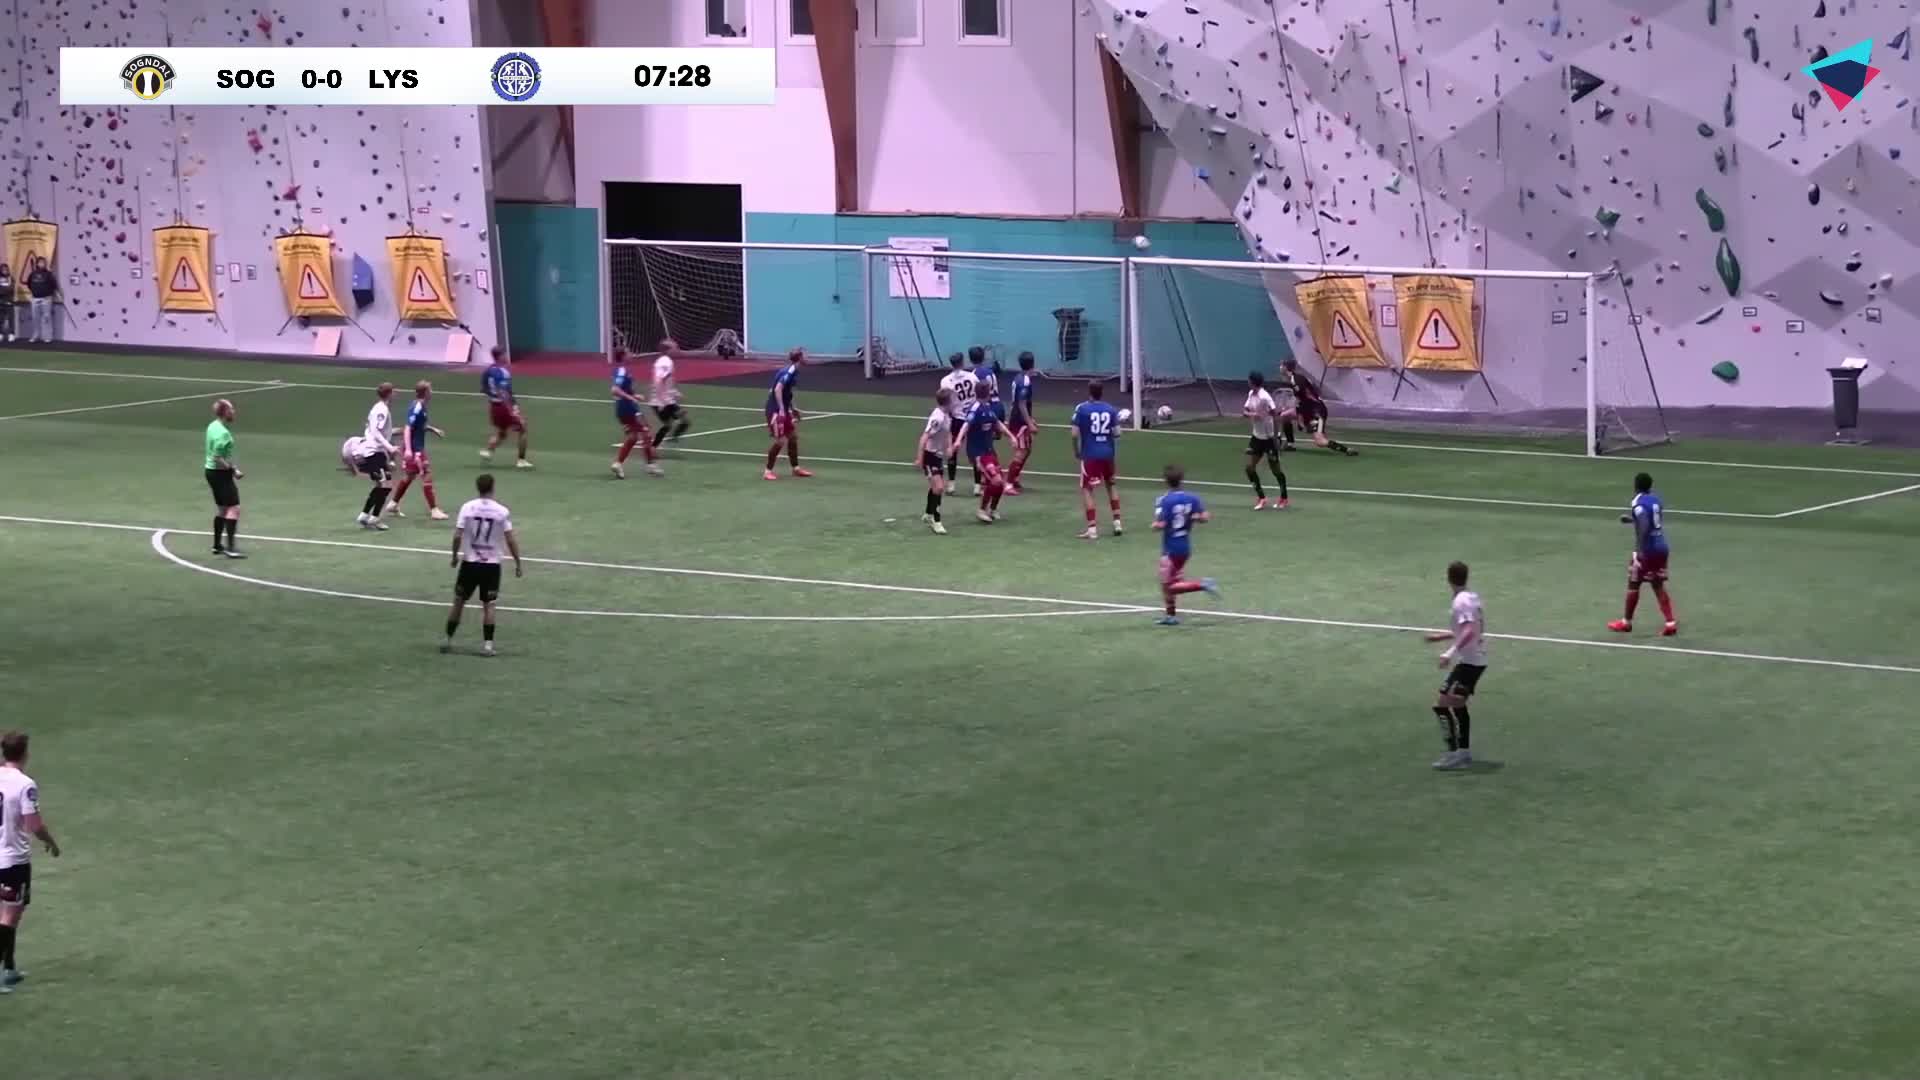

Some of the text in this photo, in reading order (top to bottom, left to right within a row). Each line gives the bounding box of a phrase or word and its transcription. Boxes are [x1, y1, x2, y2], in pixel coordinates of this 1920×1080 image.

[954, 379, 975, 401] 32
[1090, 411, 1111, 434] 32
[472, 516, 495, 543] 77
